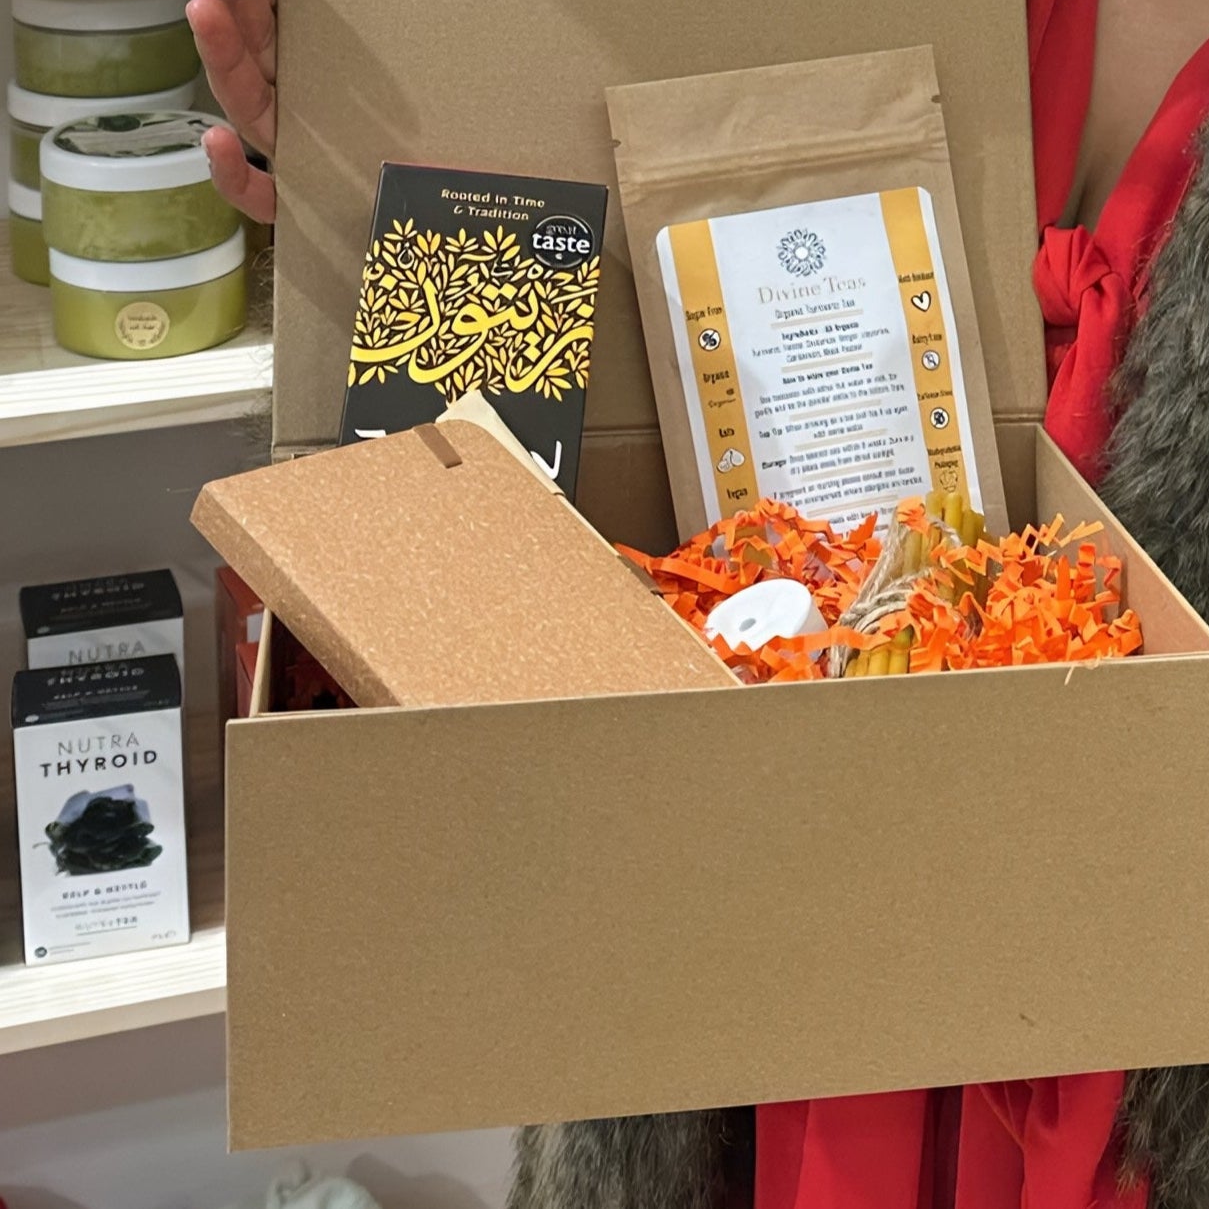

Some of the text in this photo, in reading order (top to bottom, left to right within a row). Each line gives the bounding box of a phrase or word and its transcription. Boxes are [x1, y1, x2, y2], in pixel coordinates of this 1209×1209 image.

[441, 188, 490, 203] Rooted
[513, 195, 546, 208] Time
[468, 205, 530, 221] Tradition
[531, 233, 591, 254] taste
[757, 282, 822, 305] Divine
[68, 641, 146, 665] NUTRA
[58, 732, 140, 756] NUTRA
[40, 750, 157, 778] THYROID
